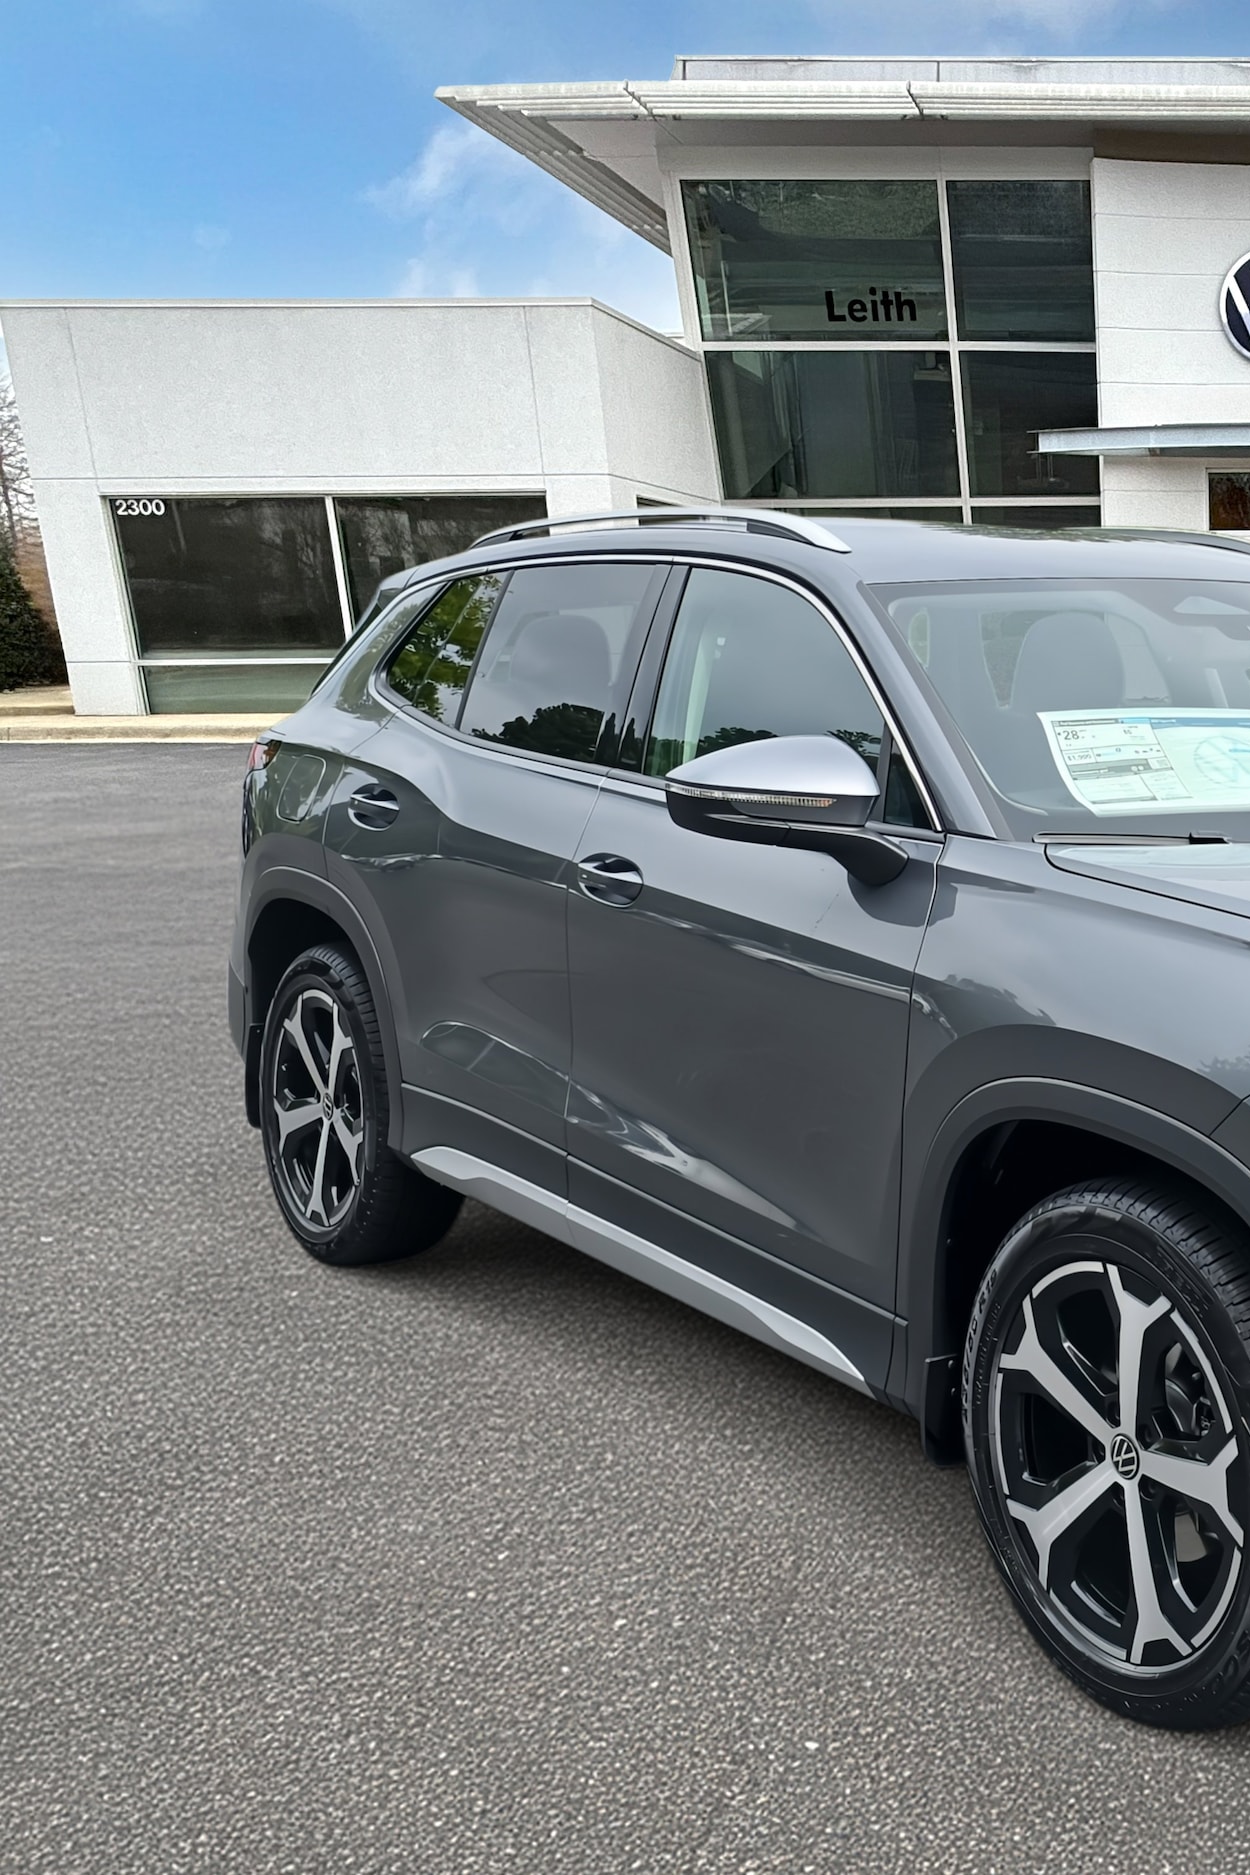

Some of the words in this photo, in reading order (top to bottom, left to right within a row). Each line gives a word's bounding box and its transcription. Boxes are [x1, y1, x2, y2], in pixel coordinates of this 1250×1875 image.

[825, 286, 917, 322] Leith
[115, 499, 165, 516] 2300
[1062, 730, 1080, 740] 28
